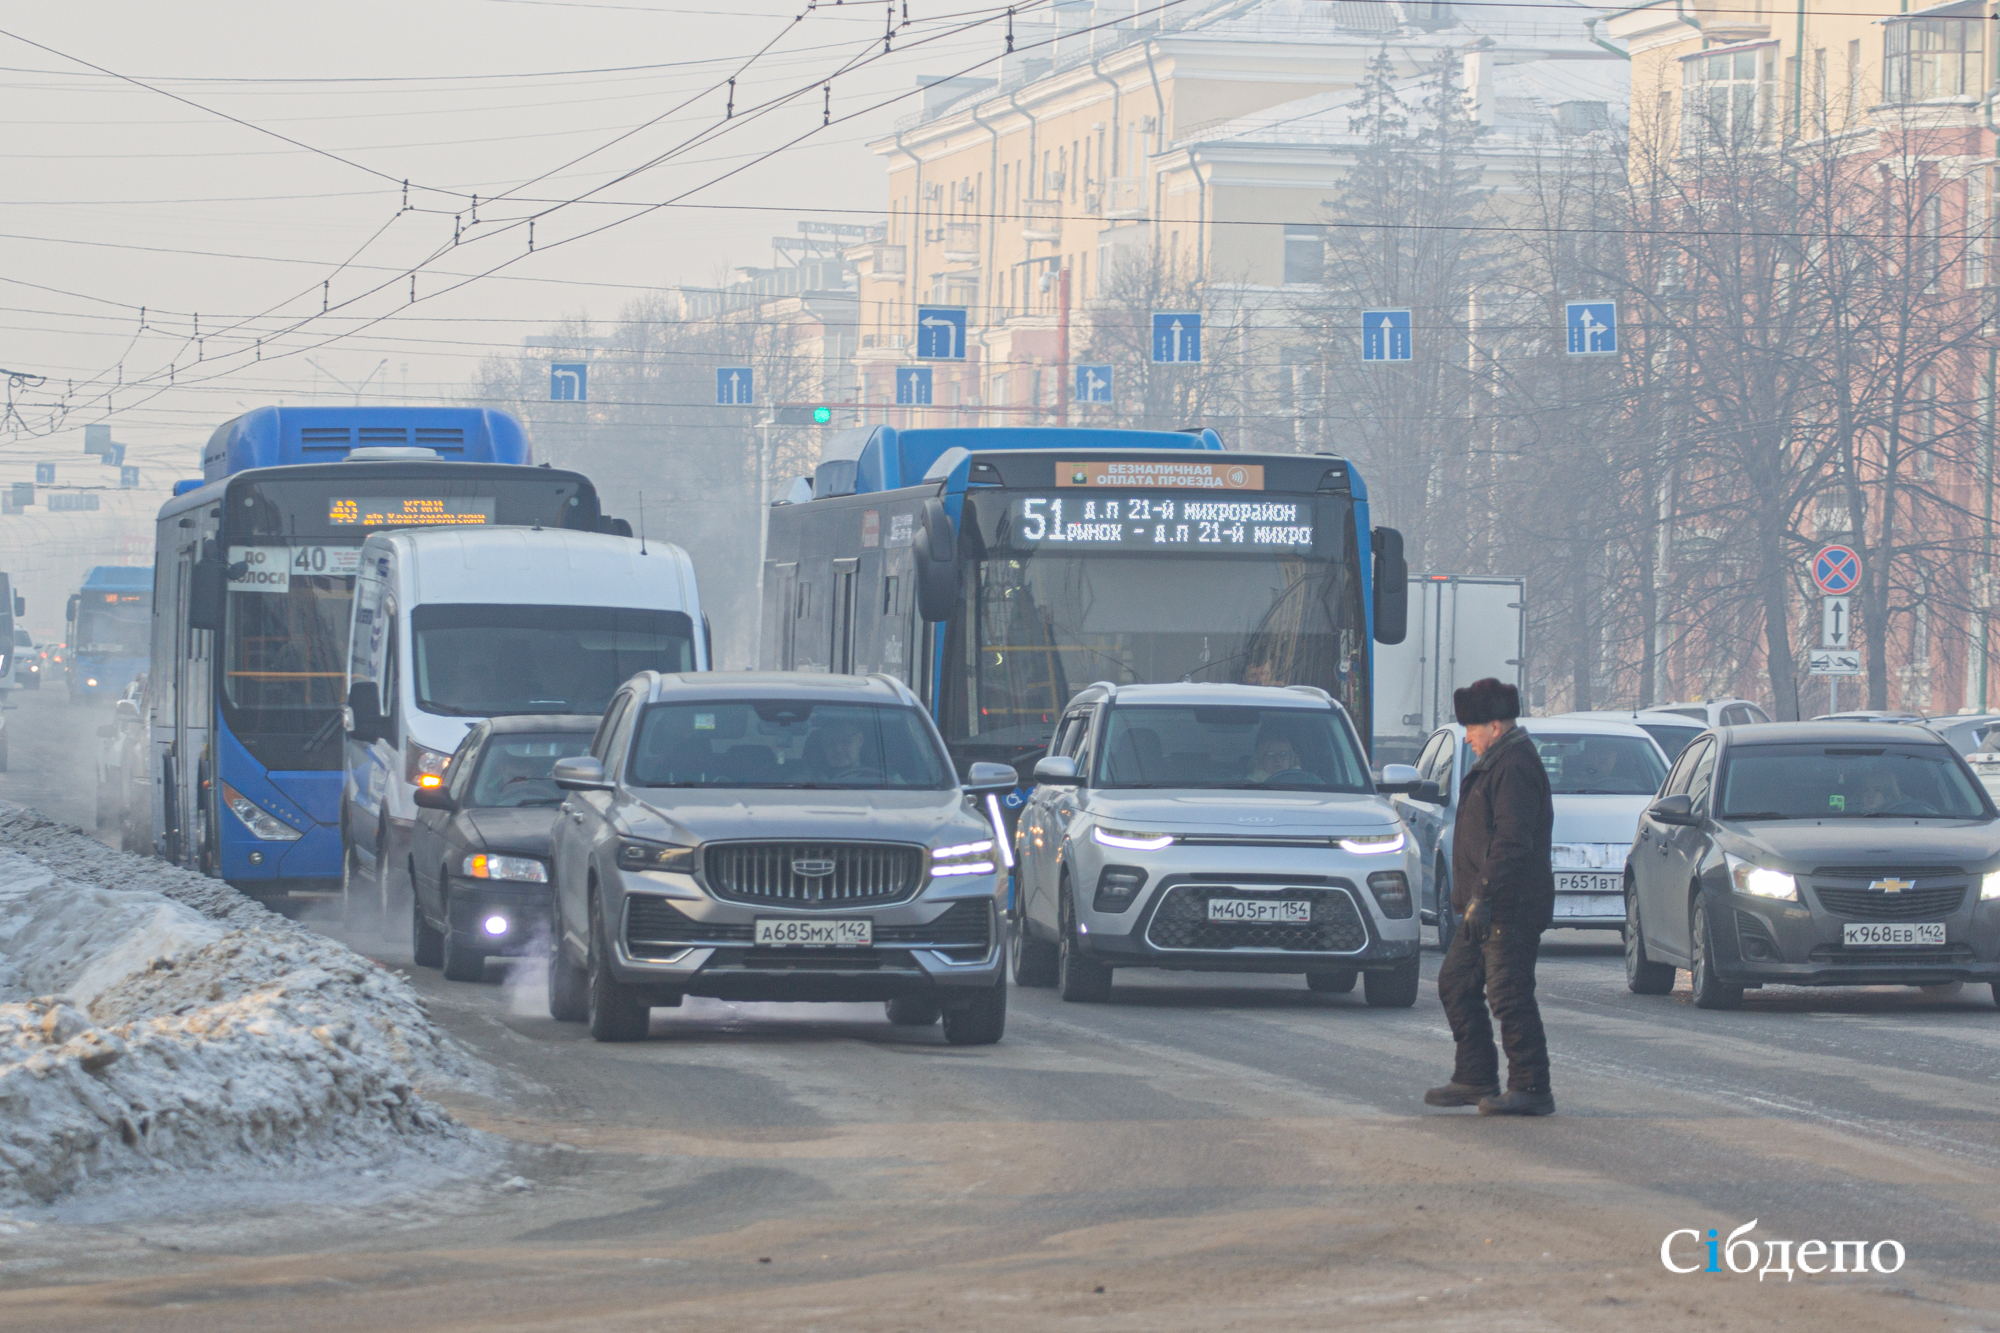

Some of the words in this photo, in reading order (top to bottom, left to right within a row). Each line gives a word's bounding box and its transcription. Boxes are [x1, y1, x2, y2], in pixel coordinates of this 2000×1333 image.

[1108, 464, 1212, 476] БЕЗНАЛИЧНАЯ
[1096, 475, 1154, 486] ОПЛАТА
[1158, 475, 1224, 488] ПРОЕЗДА
[1024, 498, 1065, 540] 51
[1184, 501, 1296, 522] микрорайон
[1066, 523, 1121, 541] рынок
[1254, 526, 1313, 545] микро
[244, 551, 266, 565] ДО
[295, 546, 326, 572] 40
[1560, 875, 1617, 889] Р651ВТ
[1212, 901, 1278, 919] М405РТ
[1282, 902, 1308, 915] 154
[762, 923, 834, 941] А685МХ
[839, 923, 866, 937] 142
[1849, 926, 1913, 943] К968ЕВ
[1918, 925, 1941, 938] 142
